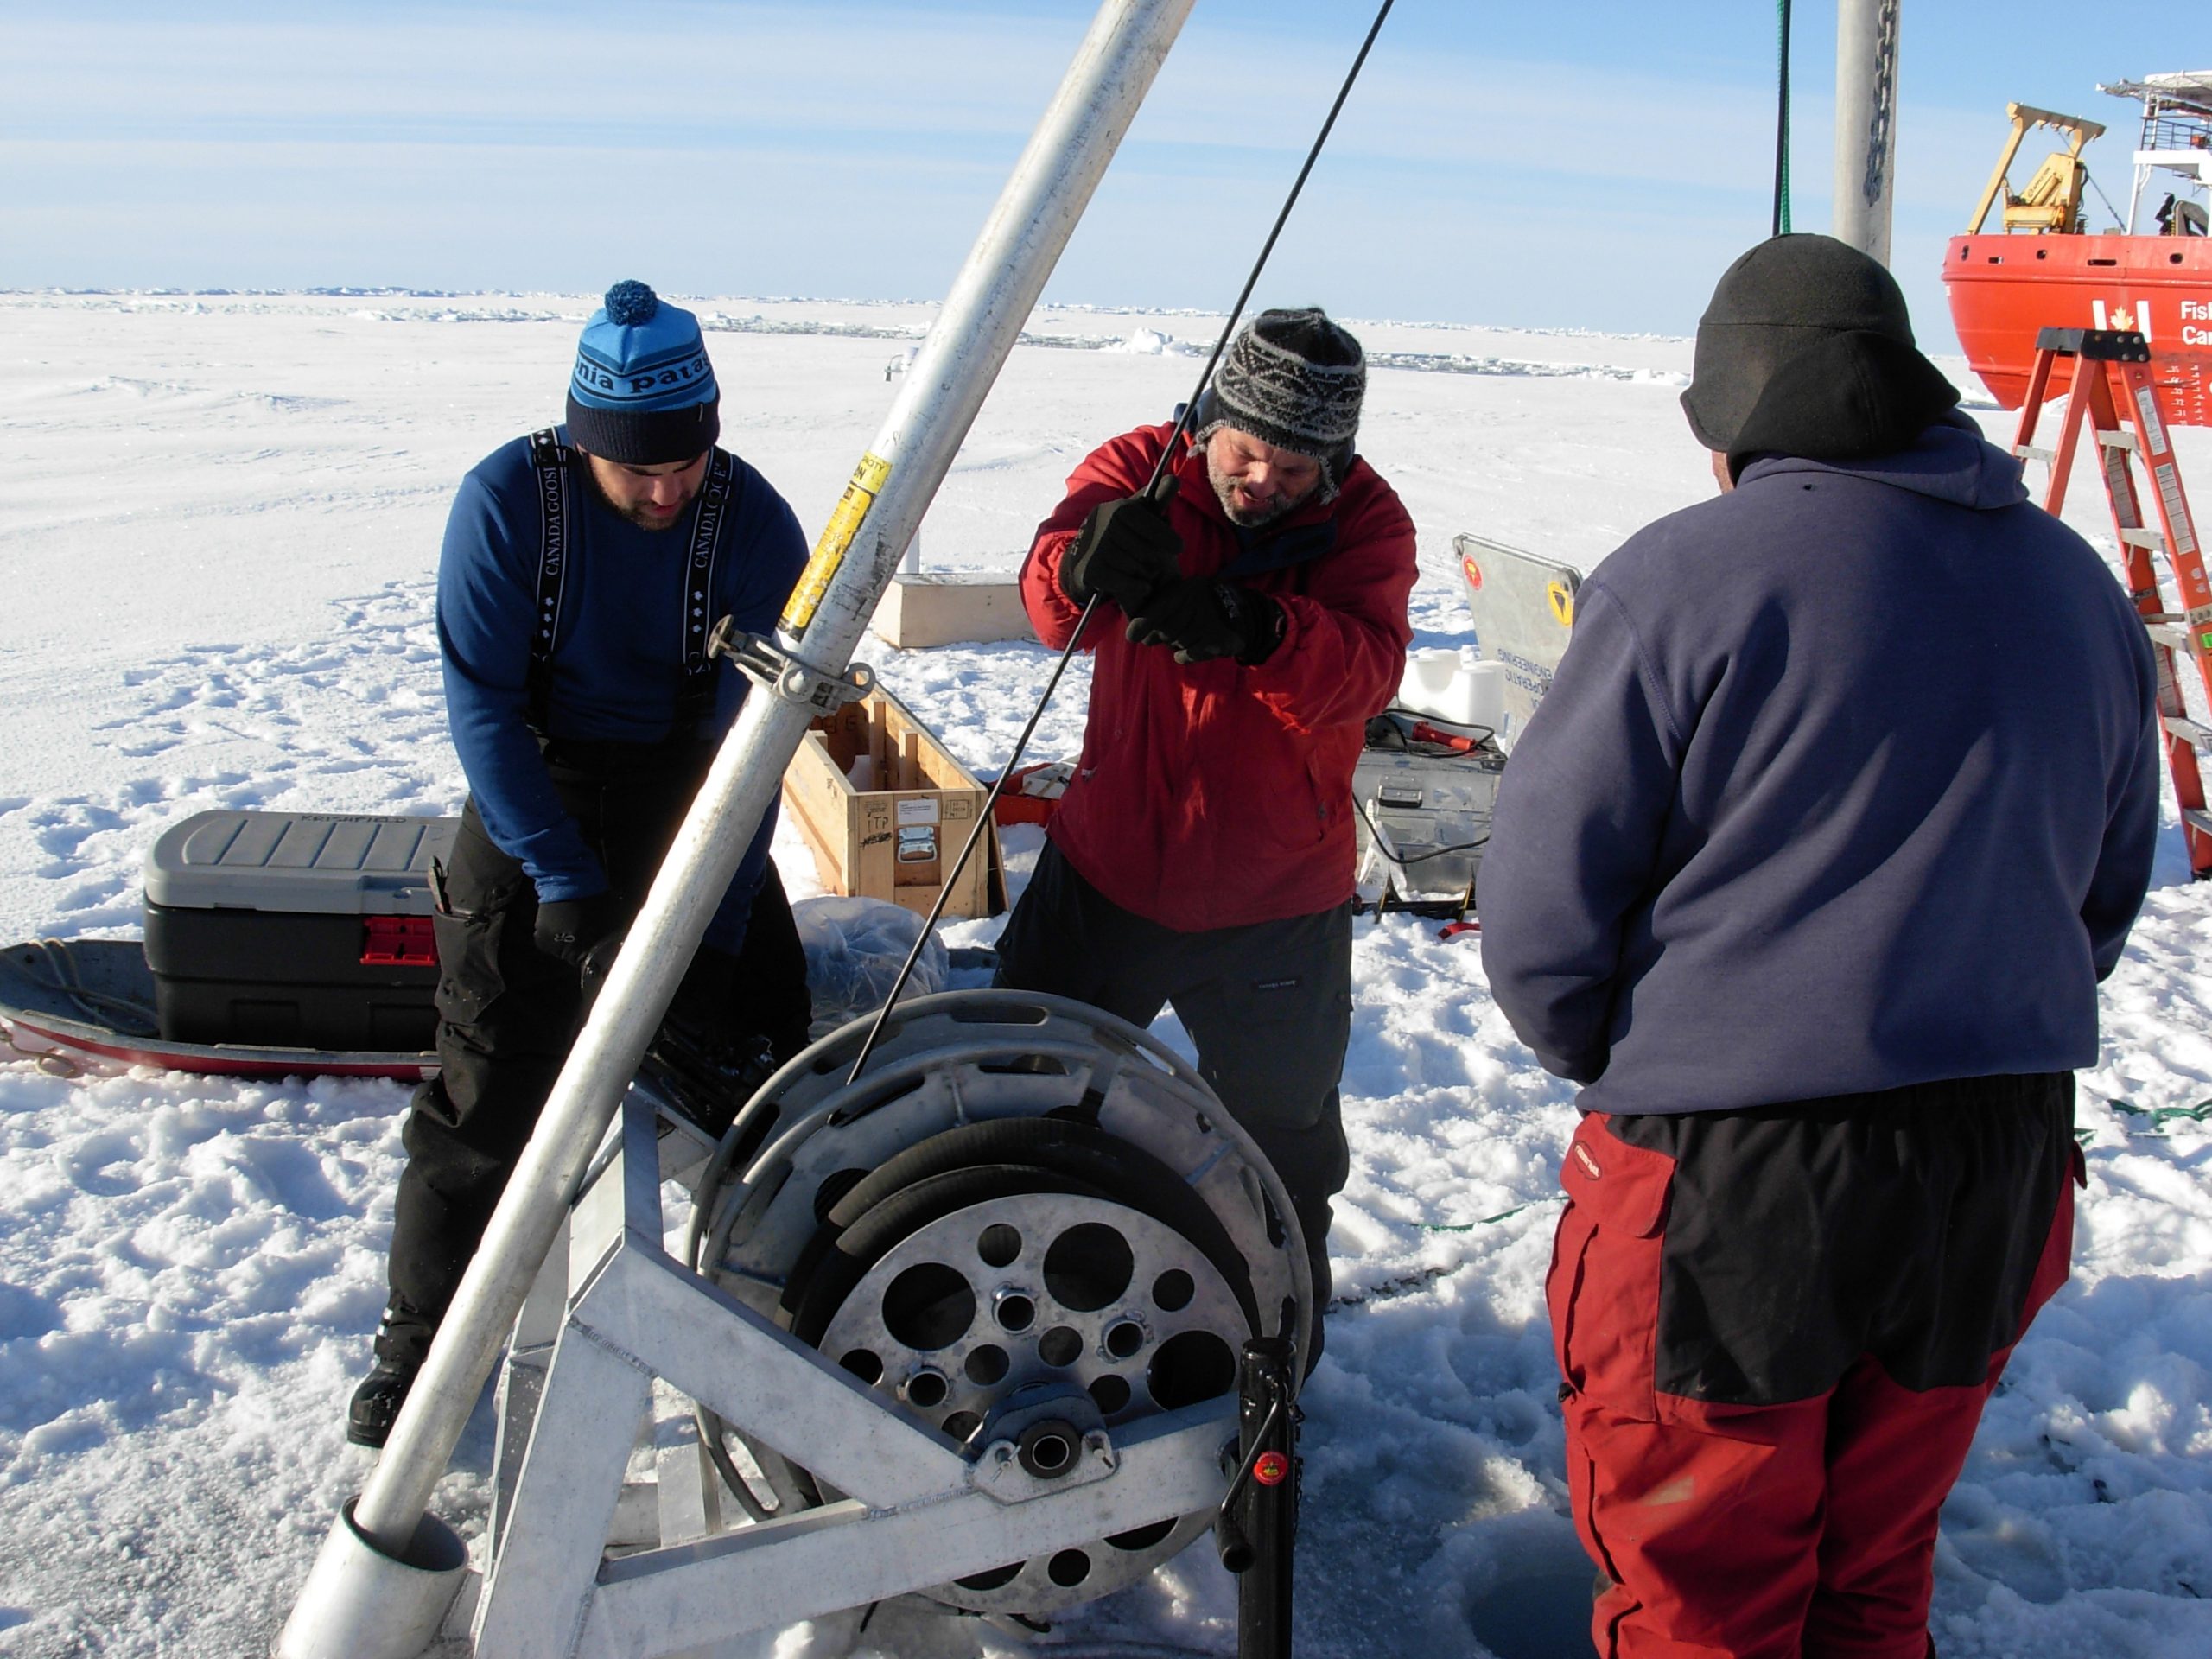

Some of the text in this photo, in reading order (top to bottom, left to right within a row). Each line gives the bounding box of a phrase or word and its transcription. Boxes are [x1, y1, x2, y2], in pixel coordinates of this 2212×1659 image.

[2180, 300, 2212, 321] Fis
[2182, 325, 2212, 346] Ca
[576, 353, 614, 391] nia
[545, 516, 561, 576] CANADA
[694, 512, 717, 569] CANADA
[1497, 648, 1554, 683] ENGINEERING
